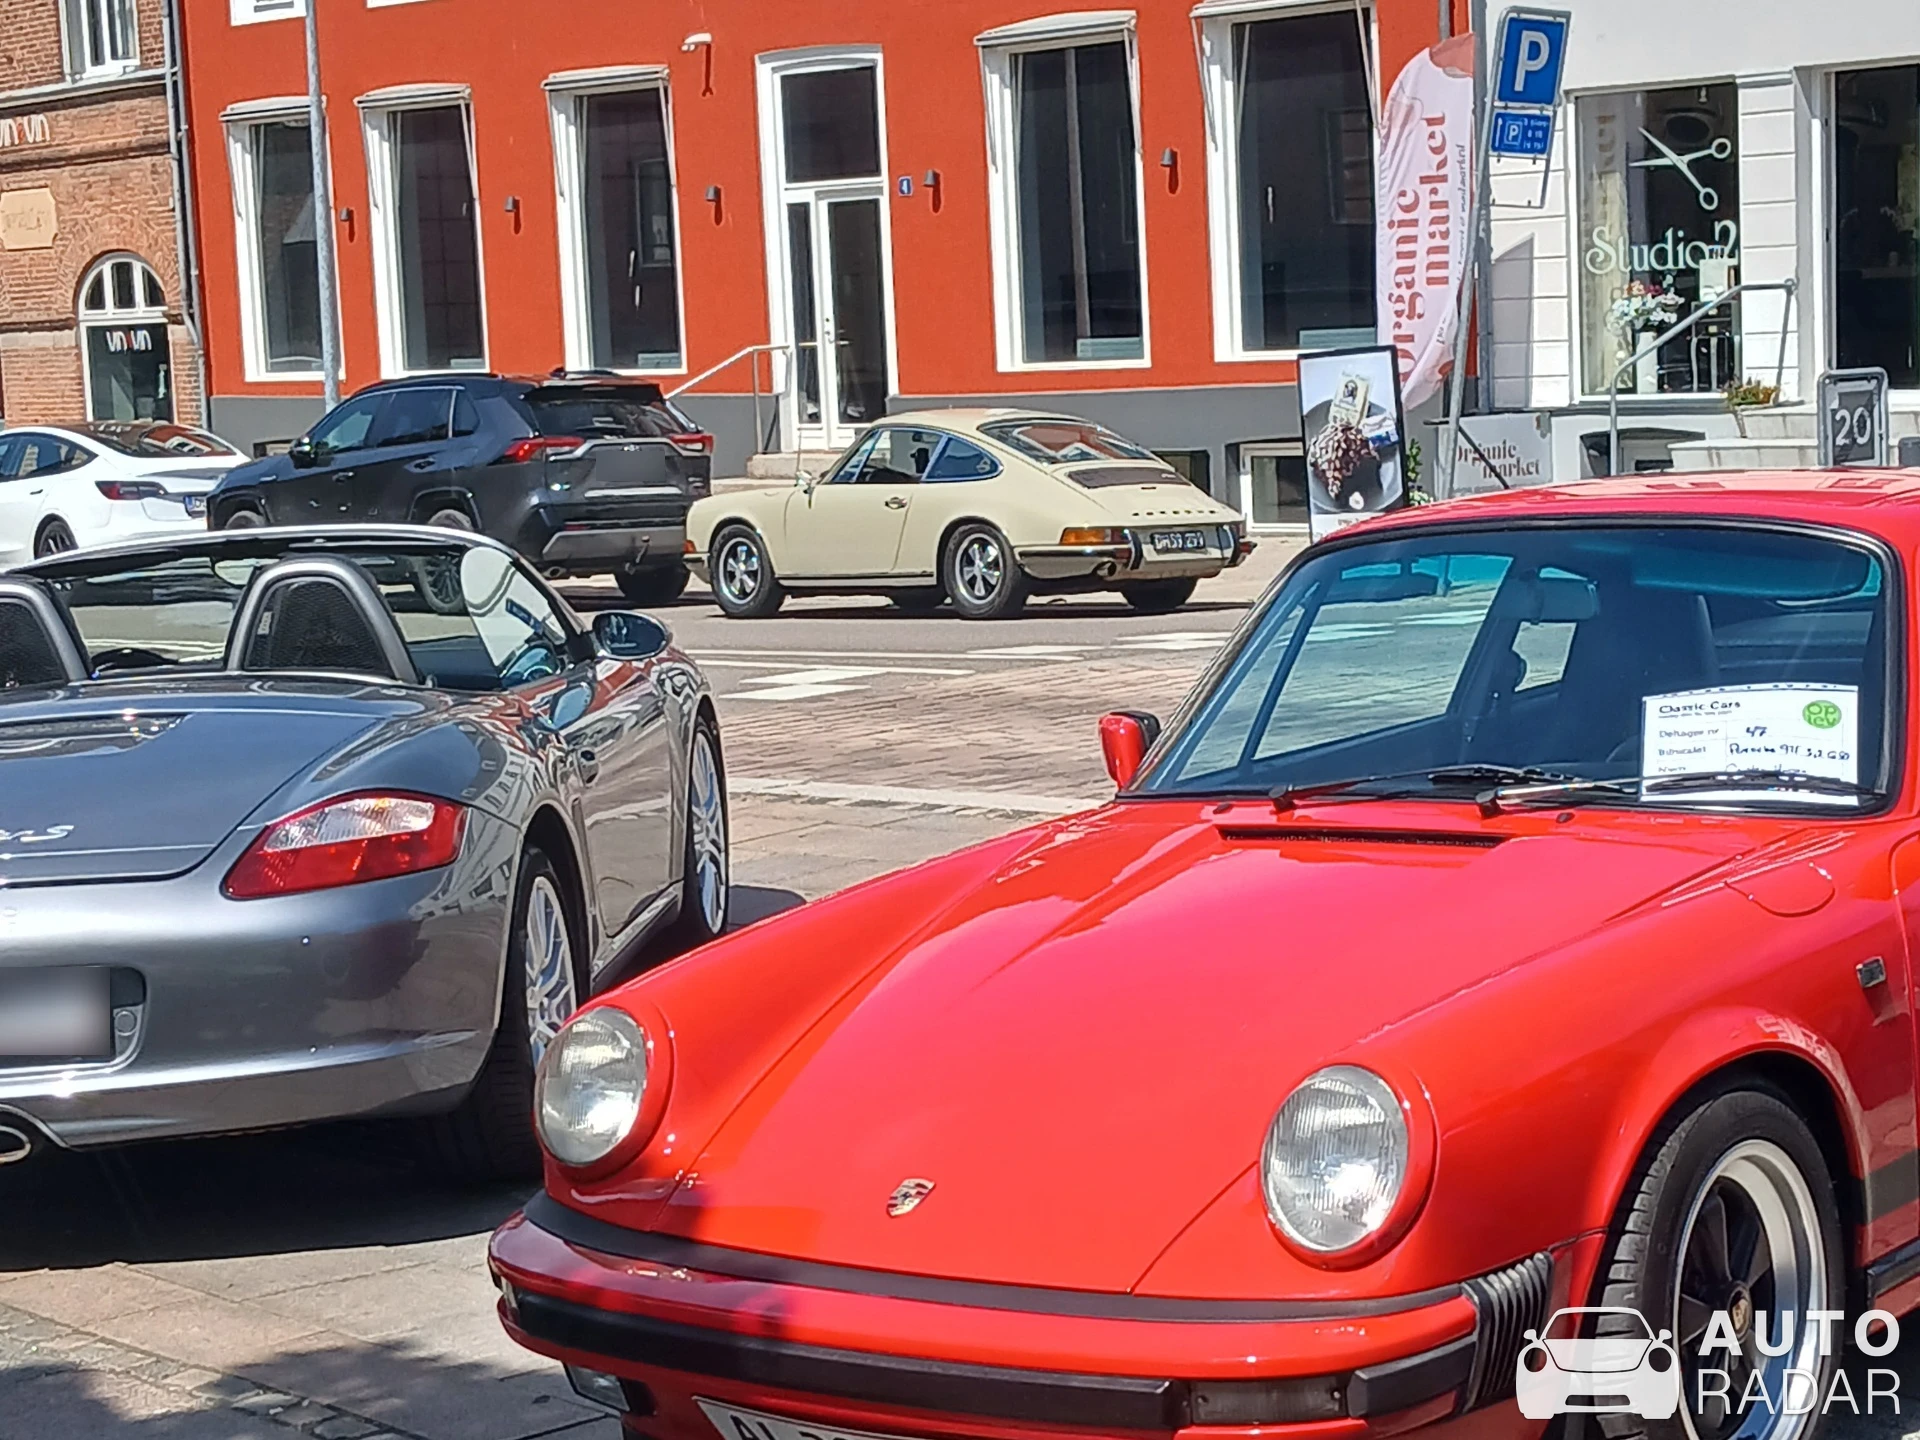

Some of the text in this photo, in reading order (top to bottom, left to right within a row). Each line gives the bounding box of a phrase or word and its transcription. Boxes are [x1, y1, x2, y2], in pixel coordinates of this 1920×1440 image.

[1514, 29, 1550, 92] P
[1418, 112, 1450, 287] market
[1834, 406, 1872, 446] 20
[1745, 726, 1767, 737] 47
